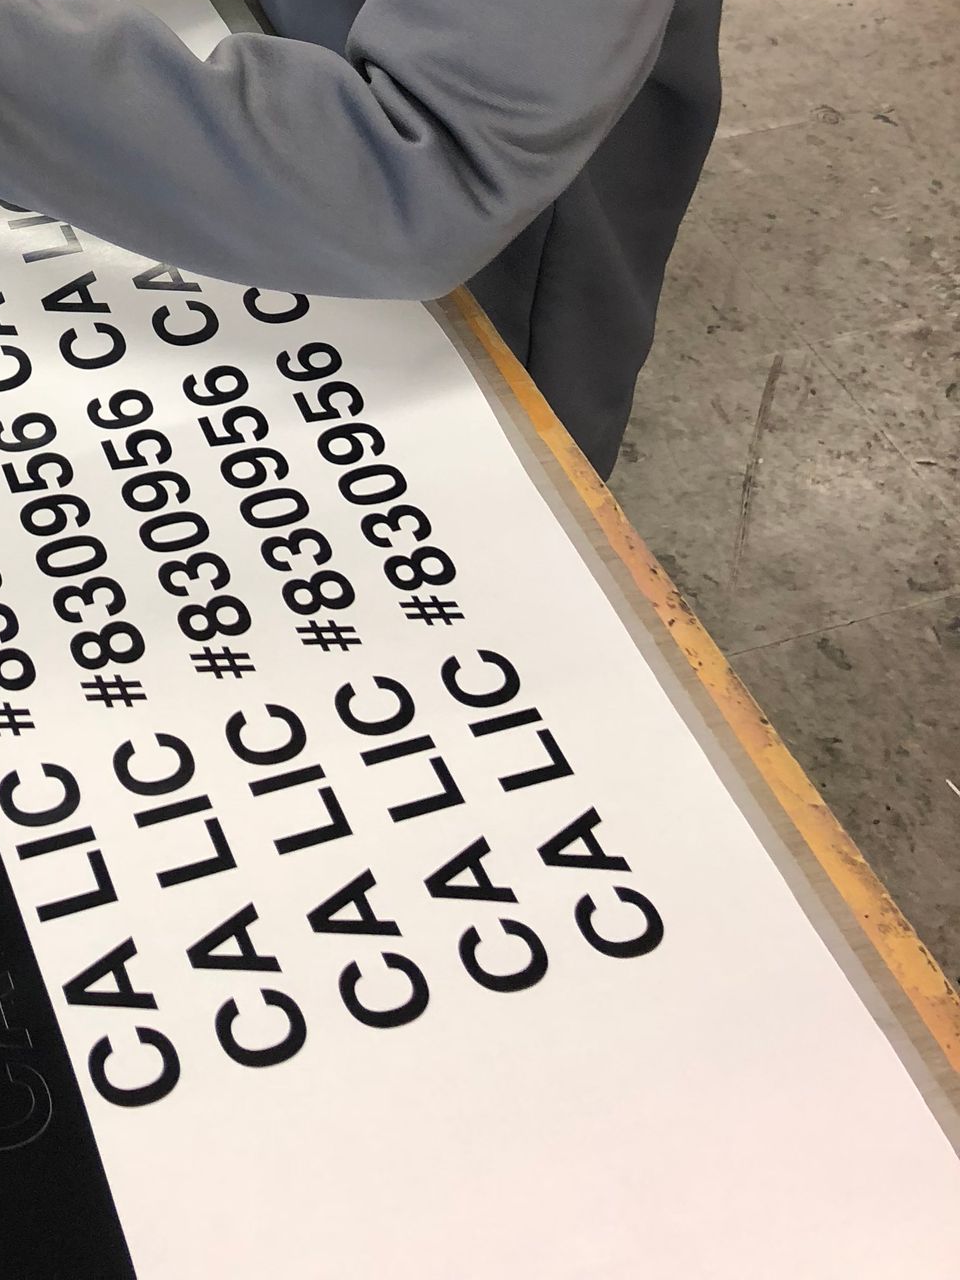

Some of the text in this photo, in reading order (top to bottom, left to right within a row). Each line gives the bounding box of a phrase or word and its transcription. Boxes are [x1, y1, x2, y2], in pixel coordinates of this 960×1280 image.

[41, 270, 127, 371] CA
[87, 388, 431, 1030] CA LIC #830956
[183, 364, 549, 994] CA LIC #830956
[276, 341, 665, 960] CA LIC #830956
[113, 732, 238, 890] LIC
[63, 935, 180, 1108] CA
[186, 901, 307, 1069] CA
